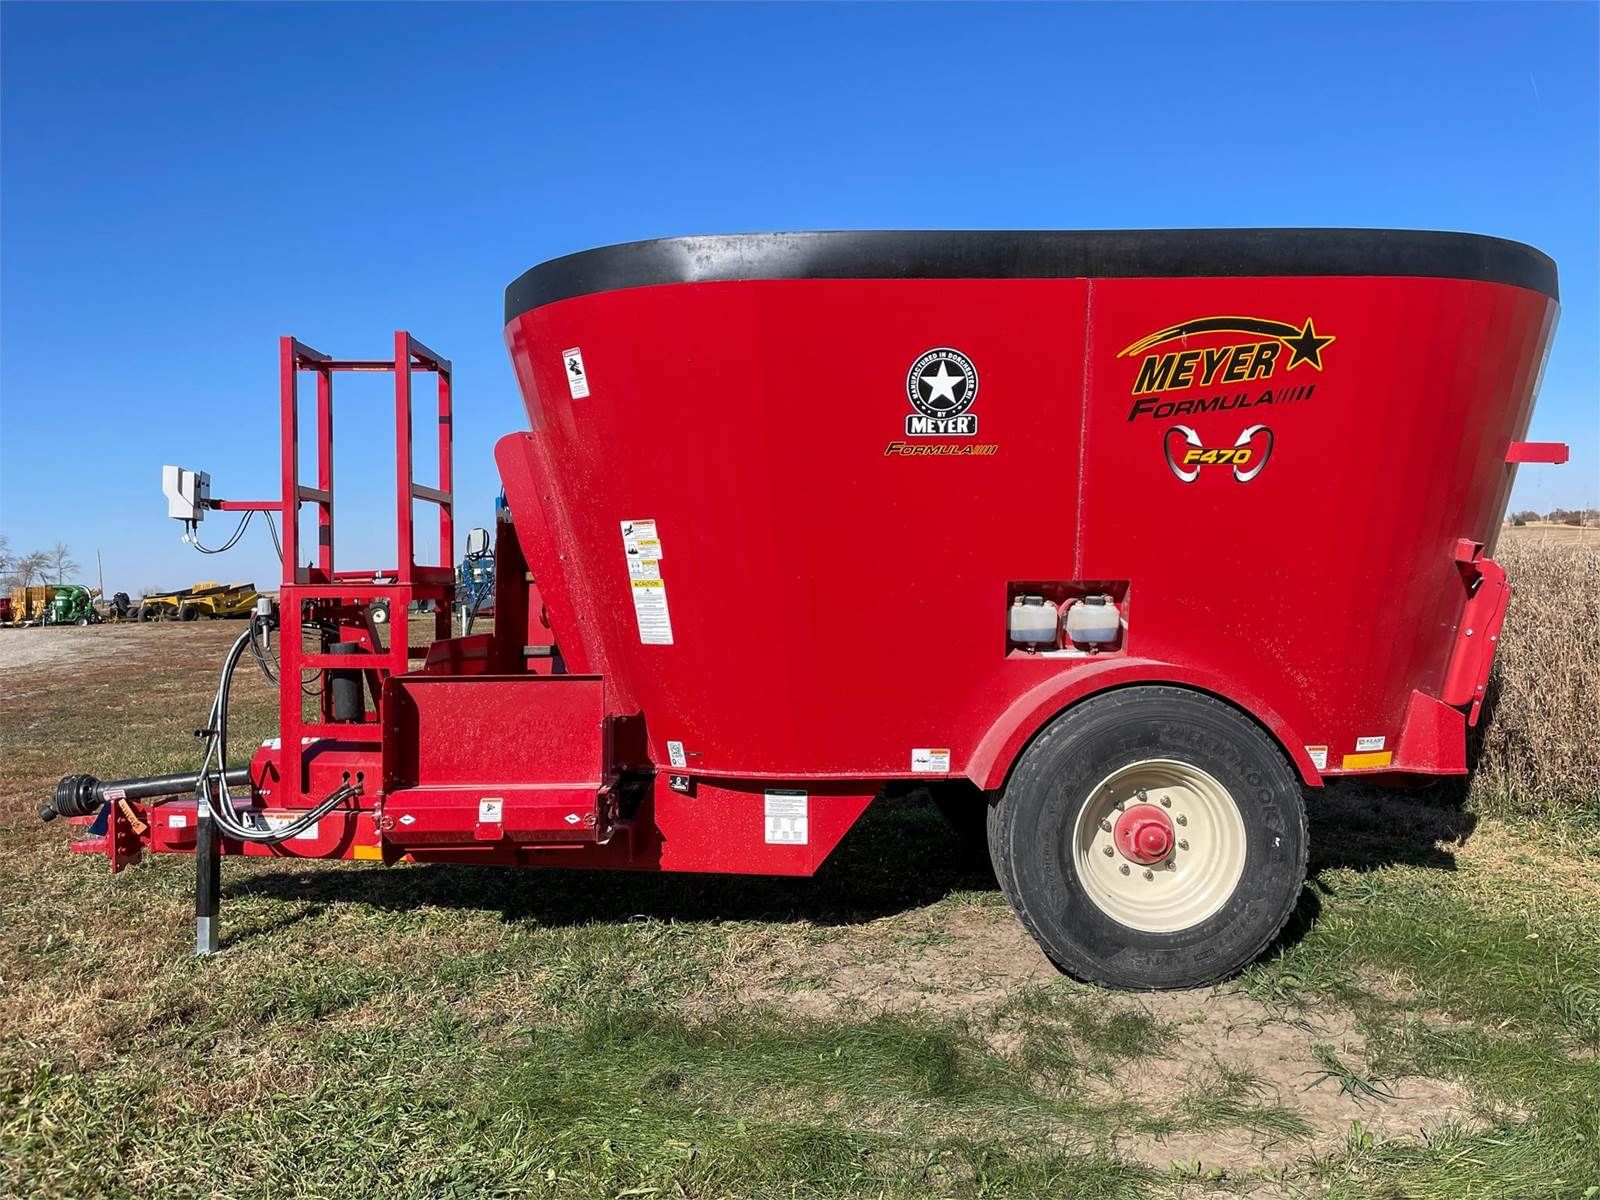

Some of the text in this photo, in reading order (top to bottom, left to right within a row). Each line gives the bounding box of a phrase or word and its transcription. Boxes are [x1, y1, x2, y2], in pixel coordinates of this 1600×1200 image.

[910, 352, 938, 399] MANUFACTURED
[948, 352, 975, 388] DORCHESTER
[1131, 340, 1281, 396] MEYER
[911, 417, 969, 434] MEYER
[1183, 448, 1253, 465] F470
